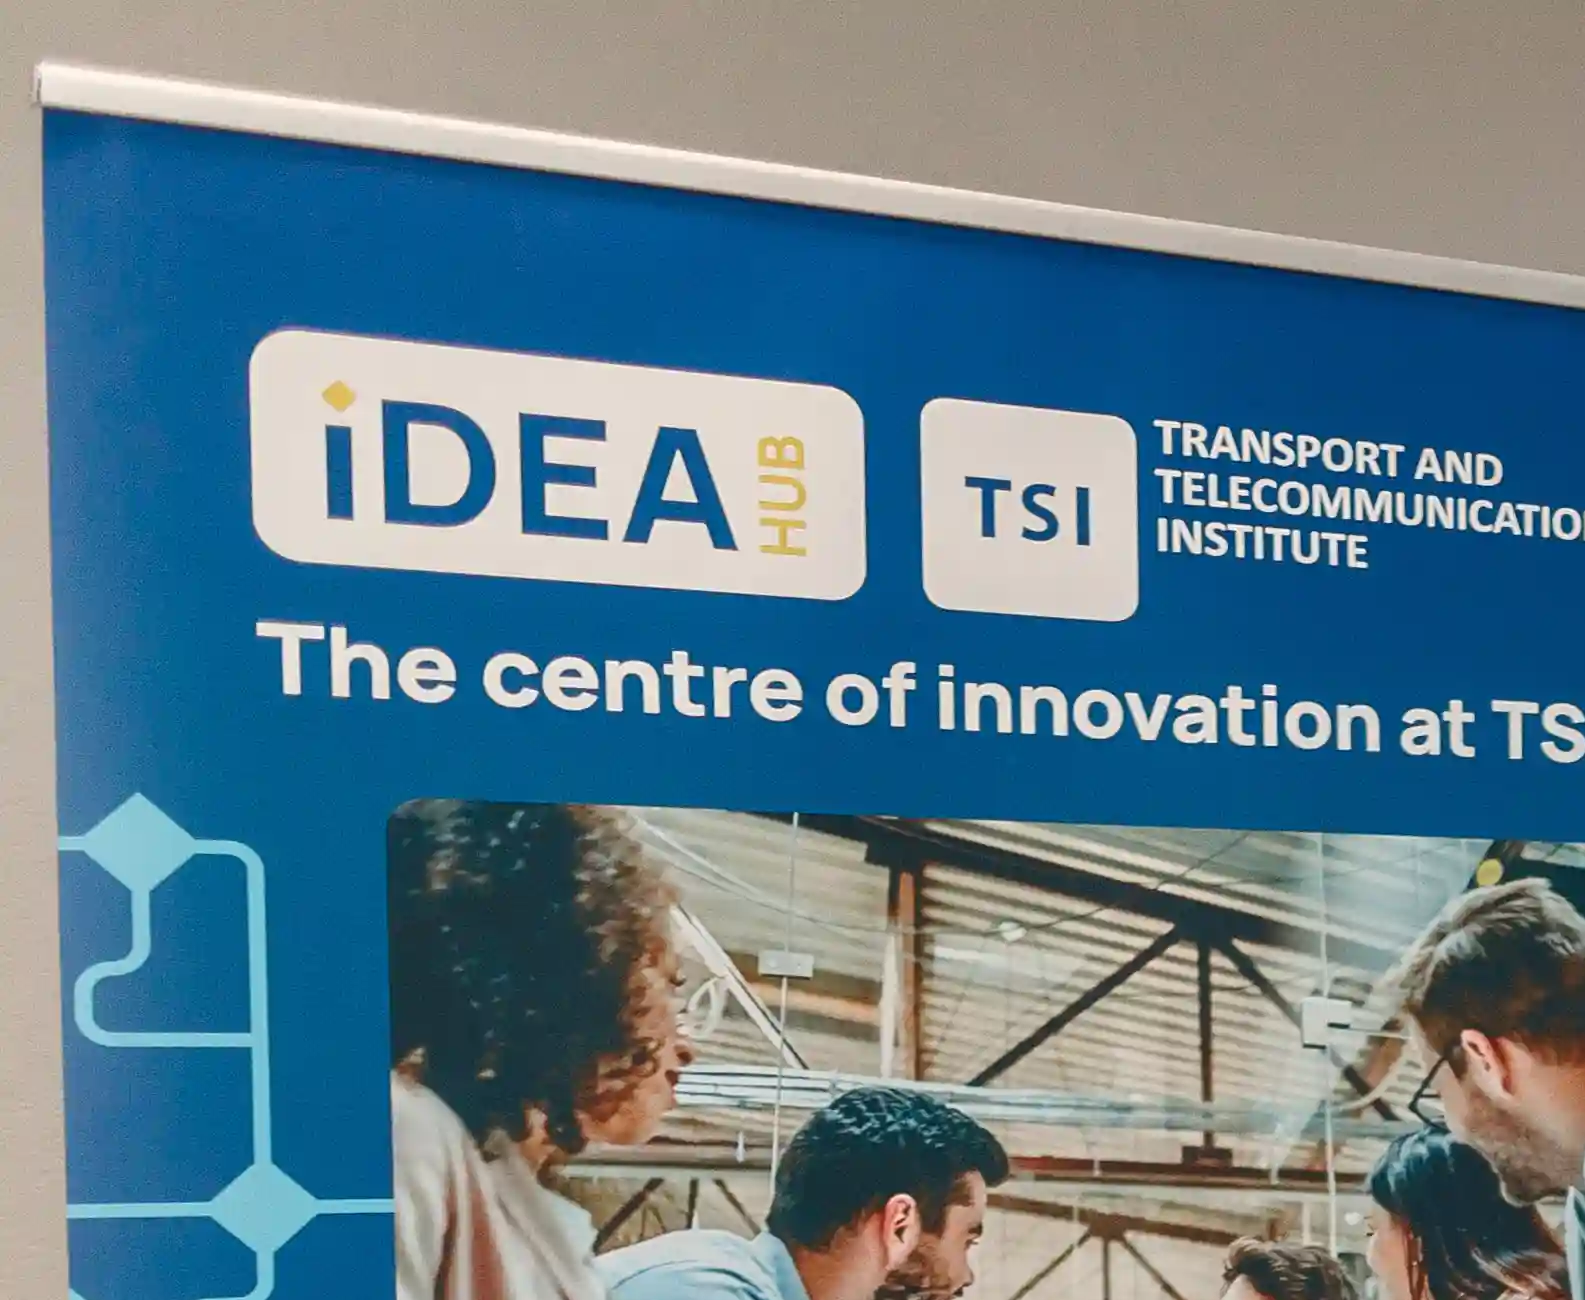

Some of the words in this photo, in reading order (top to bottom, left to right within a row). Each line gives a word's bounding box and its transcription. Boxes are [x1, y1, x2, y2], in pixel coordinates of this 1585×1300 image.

[320, 379, 739, 553] iDEA
[757, 434, 810, 557] HUB
[1153, 420, 1405, 480] TRANSPORT
[1414, 447, 1503, 487] AND
[964, 475, 1092, 549] TSI
[1156, 519, 1369, 571] INSTITUTE
[256, 621, 456, 703] The
[483, 650, 802, 722] centre
[826, 661, 916, 728] of
[939, 664, 1380, 752] innovation
[1401, 699, 1475, 757] at
